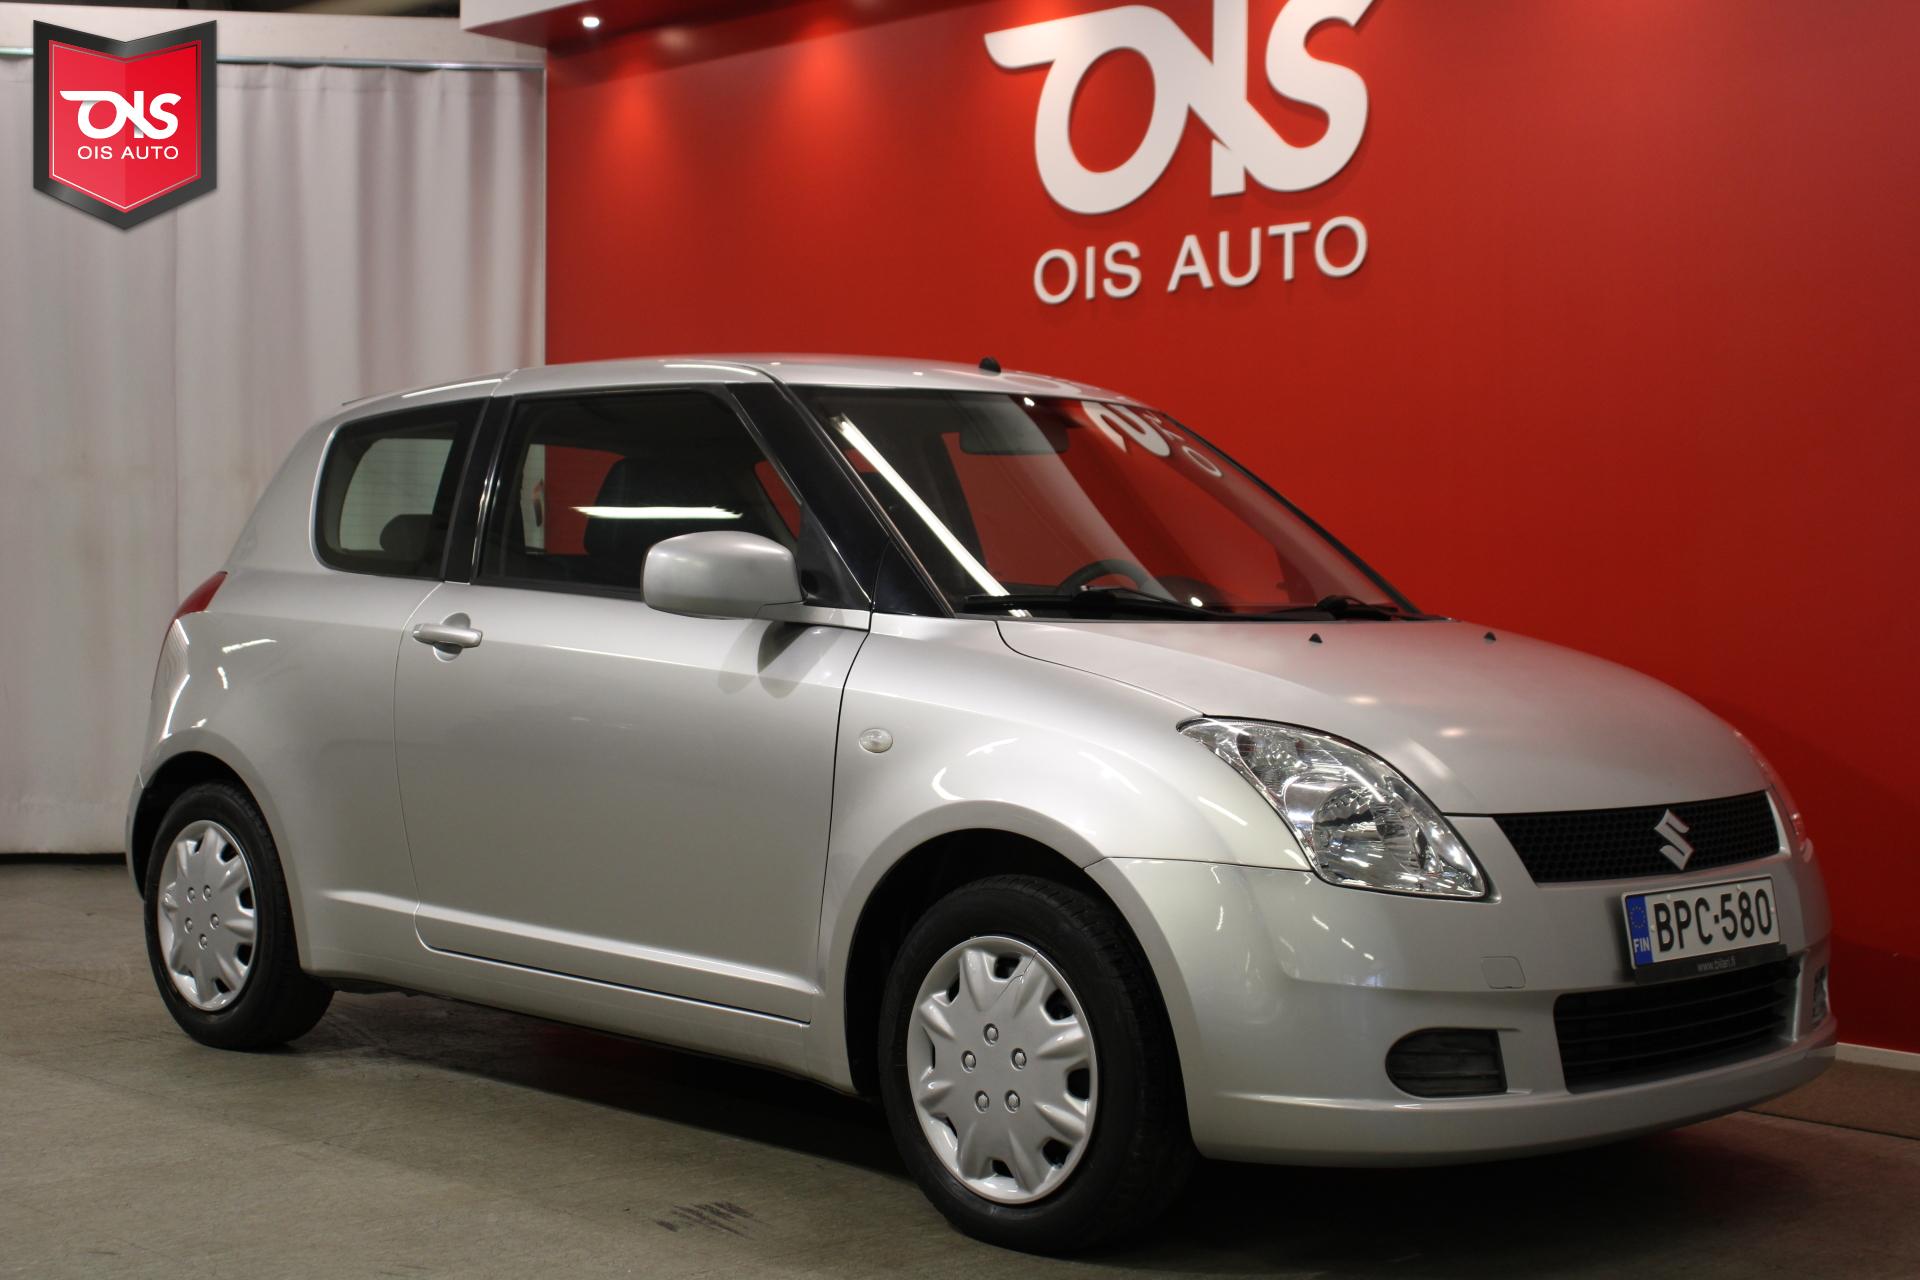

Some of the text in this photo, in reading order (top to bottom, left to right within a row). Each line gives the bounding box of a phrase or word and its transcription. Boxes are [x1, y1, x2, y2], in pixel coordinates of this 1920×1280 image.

[1034, 216, 1368, 304] OIS AUTO
[1633, 936, 1650, 953] FIN
[1654, 888, 1772, 952] BPC-580
